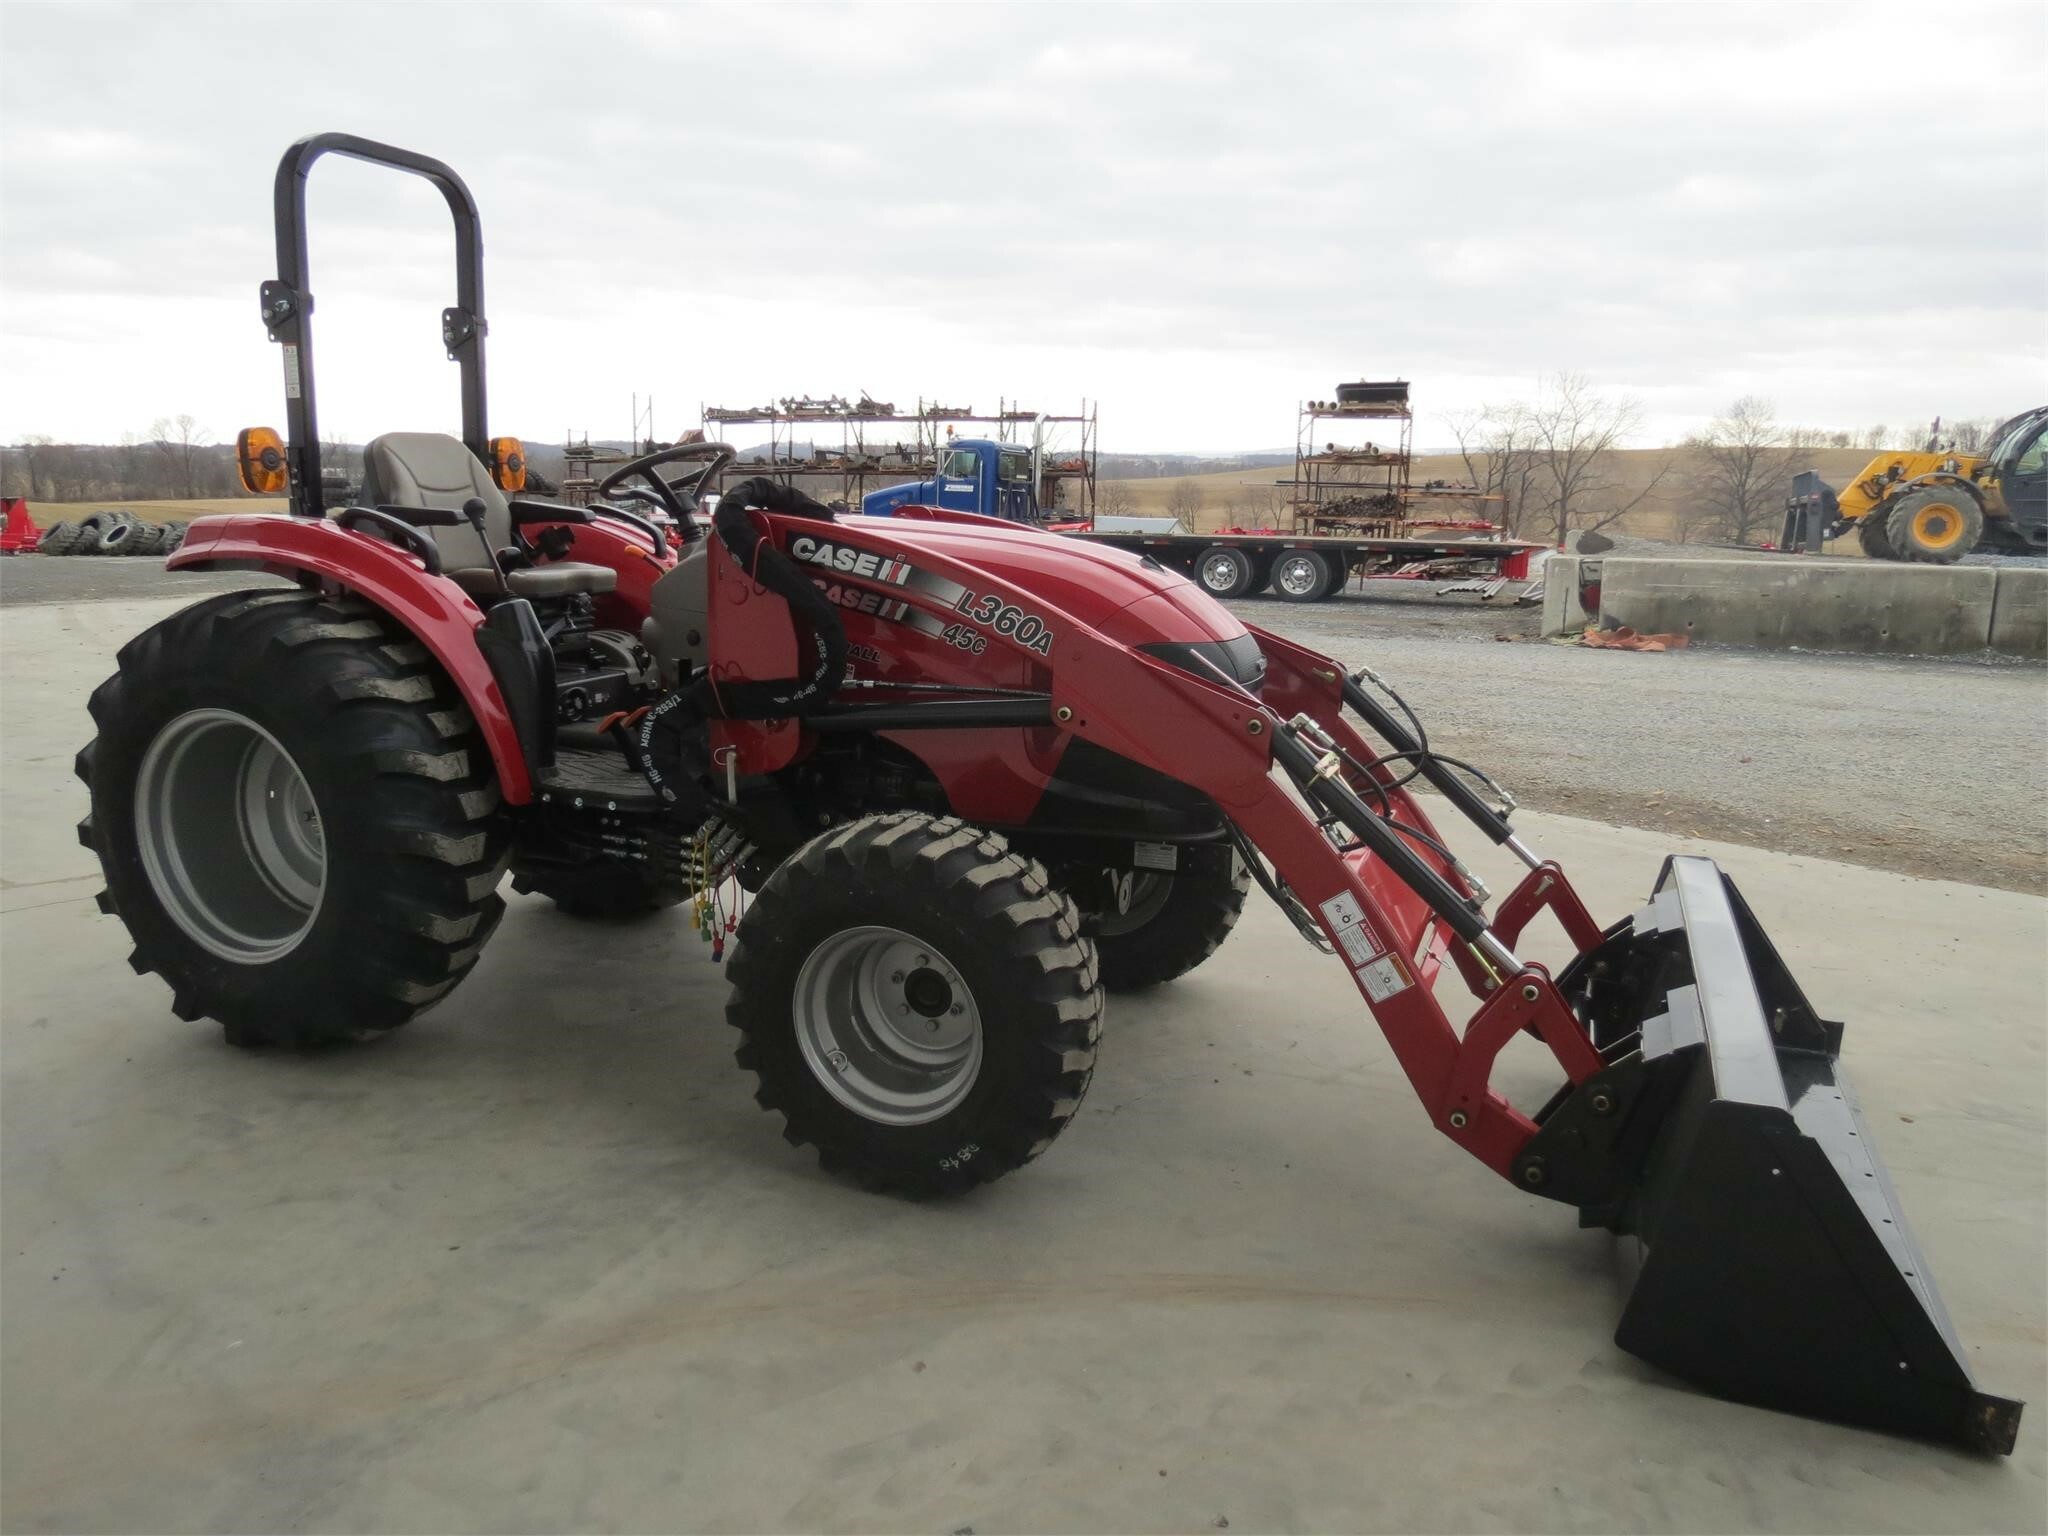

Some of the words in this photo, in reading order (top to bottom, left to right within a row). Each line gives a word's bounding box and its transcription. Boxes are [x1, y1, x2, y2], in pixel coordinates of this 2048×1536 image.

[793, 538, 880, 578] CASE
[955, 590, 1054, 656] L360A
[640, 721, 654, 748] MSHA
